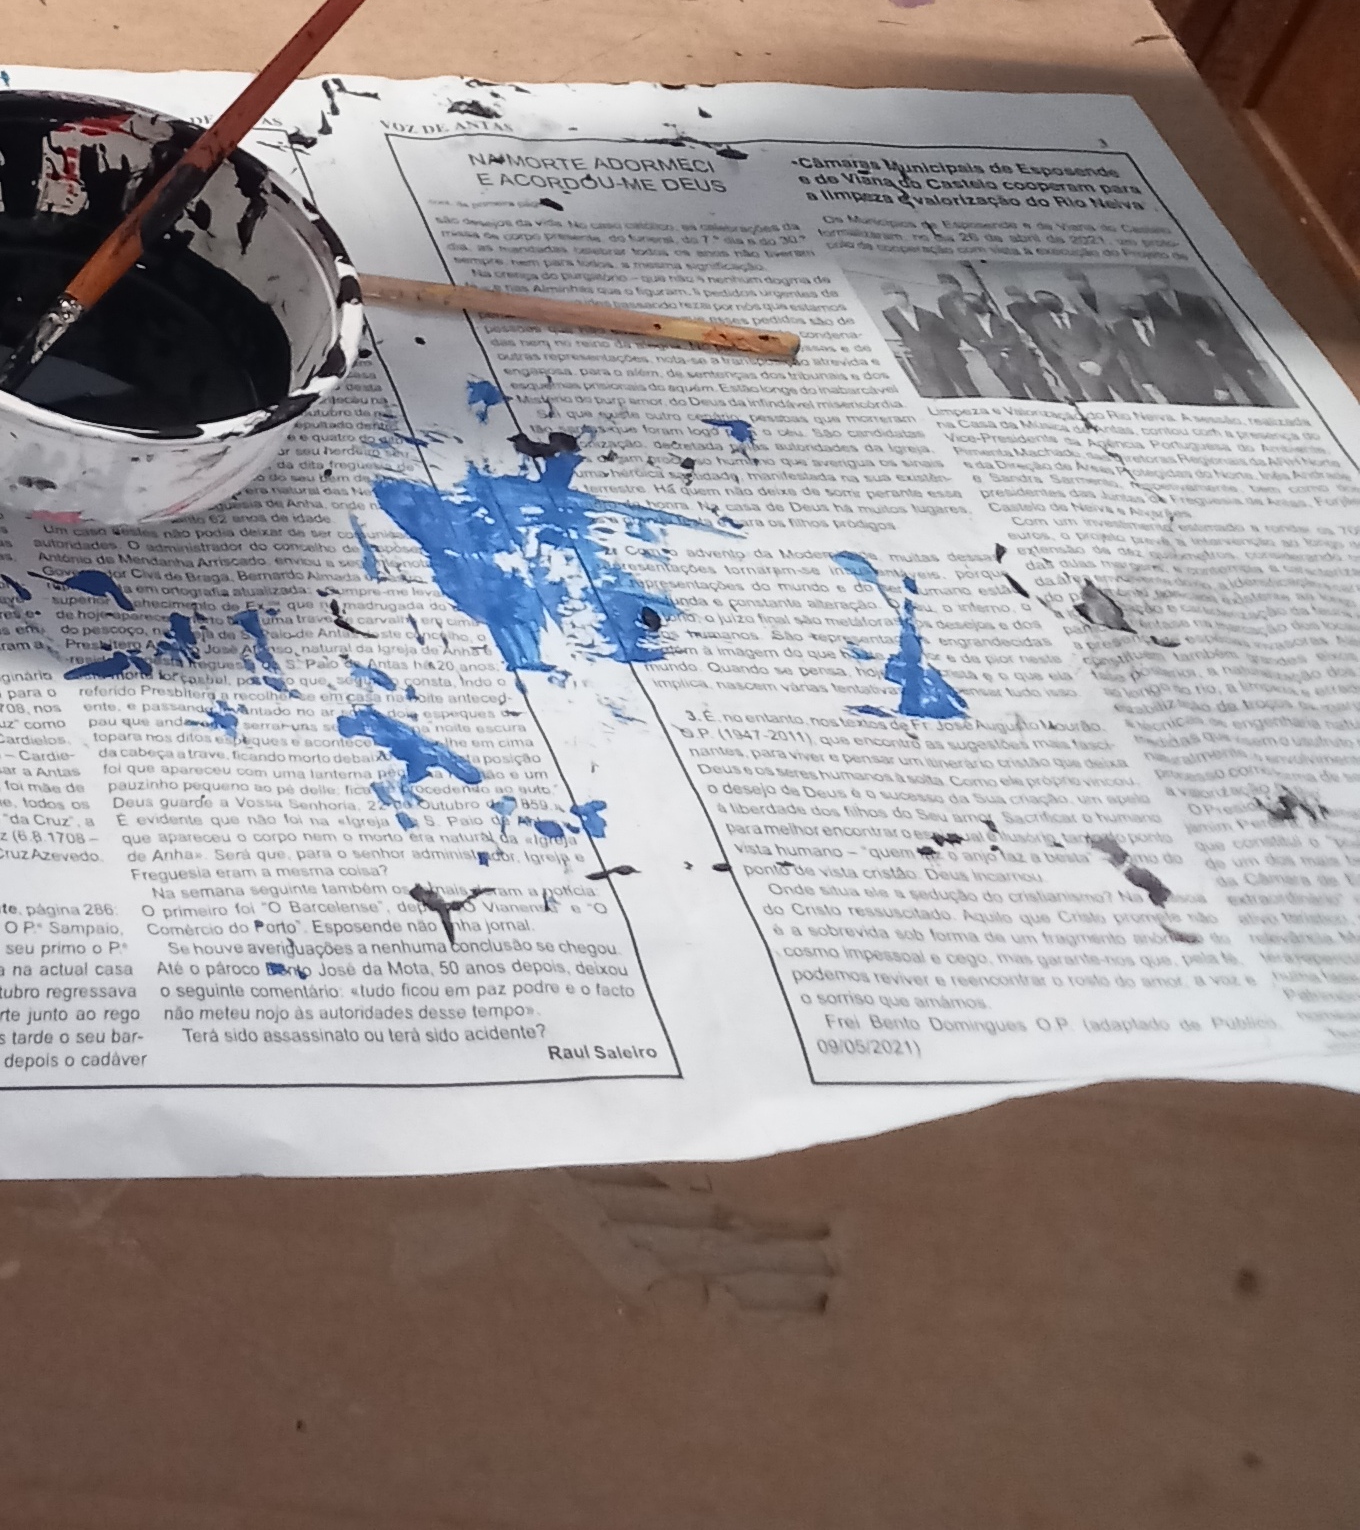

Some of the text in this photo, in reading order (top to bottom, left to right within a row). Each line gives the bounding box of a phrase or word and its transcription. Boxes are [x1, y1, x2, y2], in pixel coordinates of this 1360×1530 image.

[380, 120, 418, 134] VOZ
[423, 123, 447, 134] DE
[504, 154, 587, 171] MORTE
[595, 158, 715, 173] ADORMECI
[882, 158, 985, 174] Municipais
[989, 162, 1012, 173] de
[1018, 163, 1120, 179] Esposende
[478, 174, 726, 192] E ACORDOU-ME DEUS
[798, 176, 811, 185] e
[815, 174, 839, 185] de
[926, 177, 998, 190] Castelo
[1003, 180, 1096, 194] cooperam
[1100, 184, 1141, 196] para
[806, 191, 818, 201] a
[820, 188, 893, 204] limpeza
[915, 193, 1020, 209] valorização
[1026, 194, 1049, 207] do
[1054, 195, 1085, 208] Rio
[1090, 196, 1145, 210] Neiva
[26, 903, 80, 919] página
[183, 1023, 546, 1043] Terá sido assassinato ou terá sido acidente?
[825, 1014, 860, 1029] Frei
[870, 1014, 920, 1030] Bento
[928, 1016, 1028, 1036] Domingues
[12, 1030, 53, 1045] tarde
[59, 1033, 70, 1044] o
[76, 1031, 105, 1044] seu
[111, 1028, 144, 1044] bar-
[548, 1045, 658, 1060] Raul Saleiro
[817, 1040, 921, 1059] 09/05/2021)
[4, 1053, 58, 1072] depois
[64, 1055, 75, 1066] o
[81, 1052, 147, 1067] cadáver
